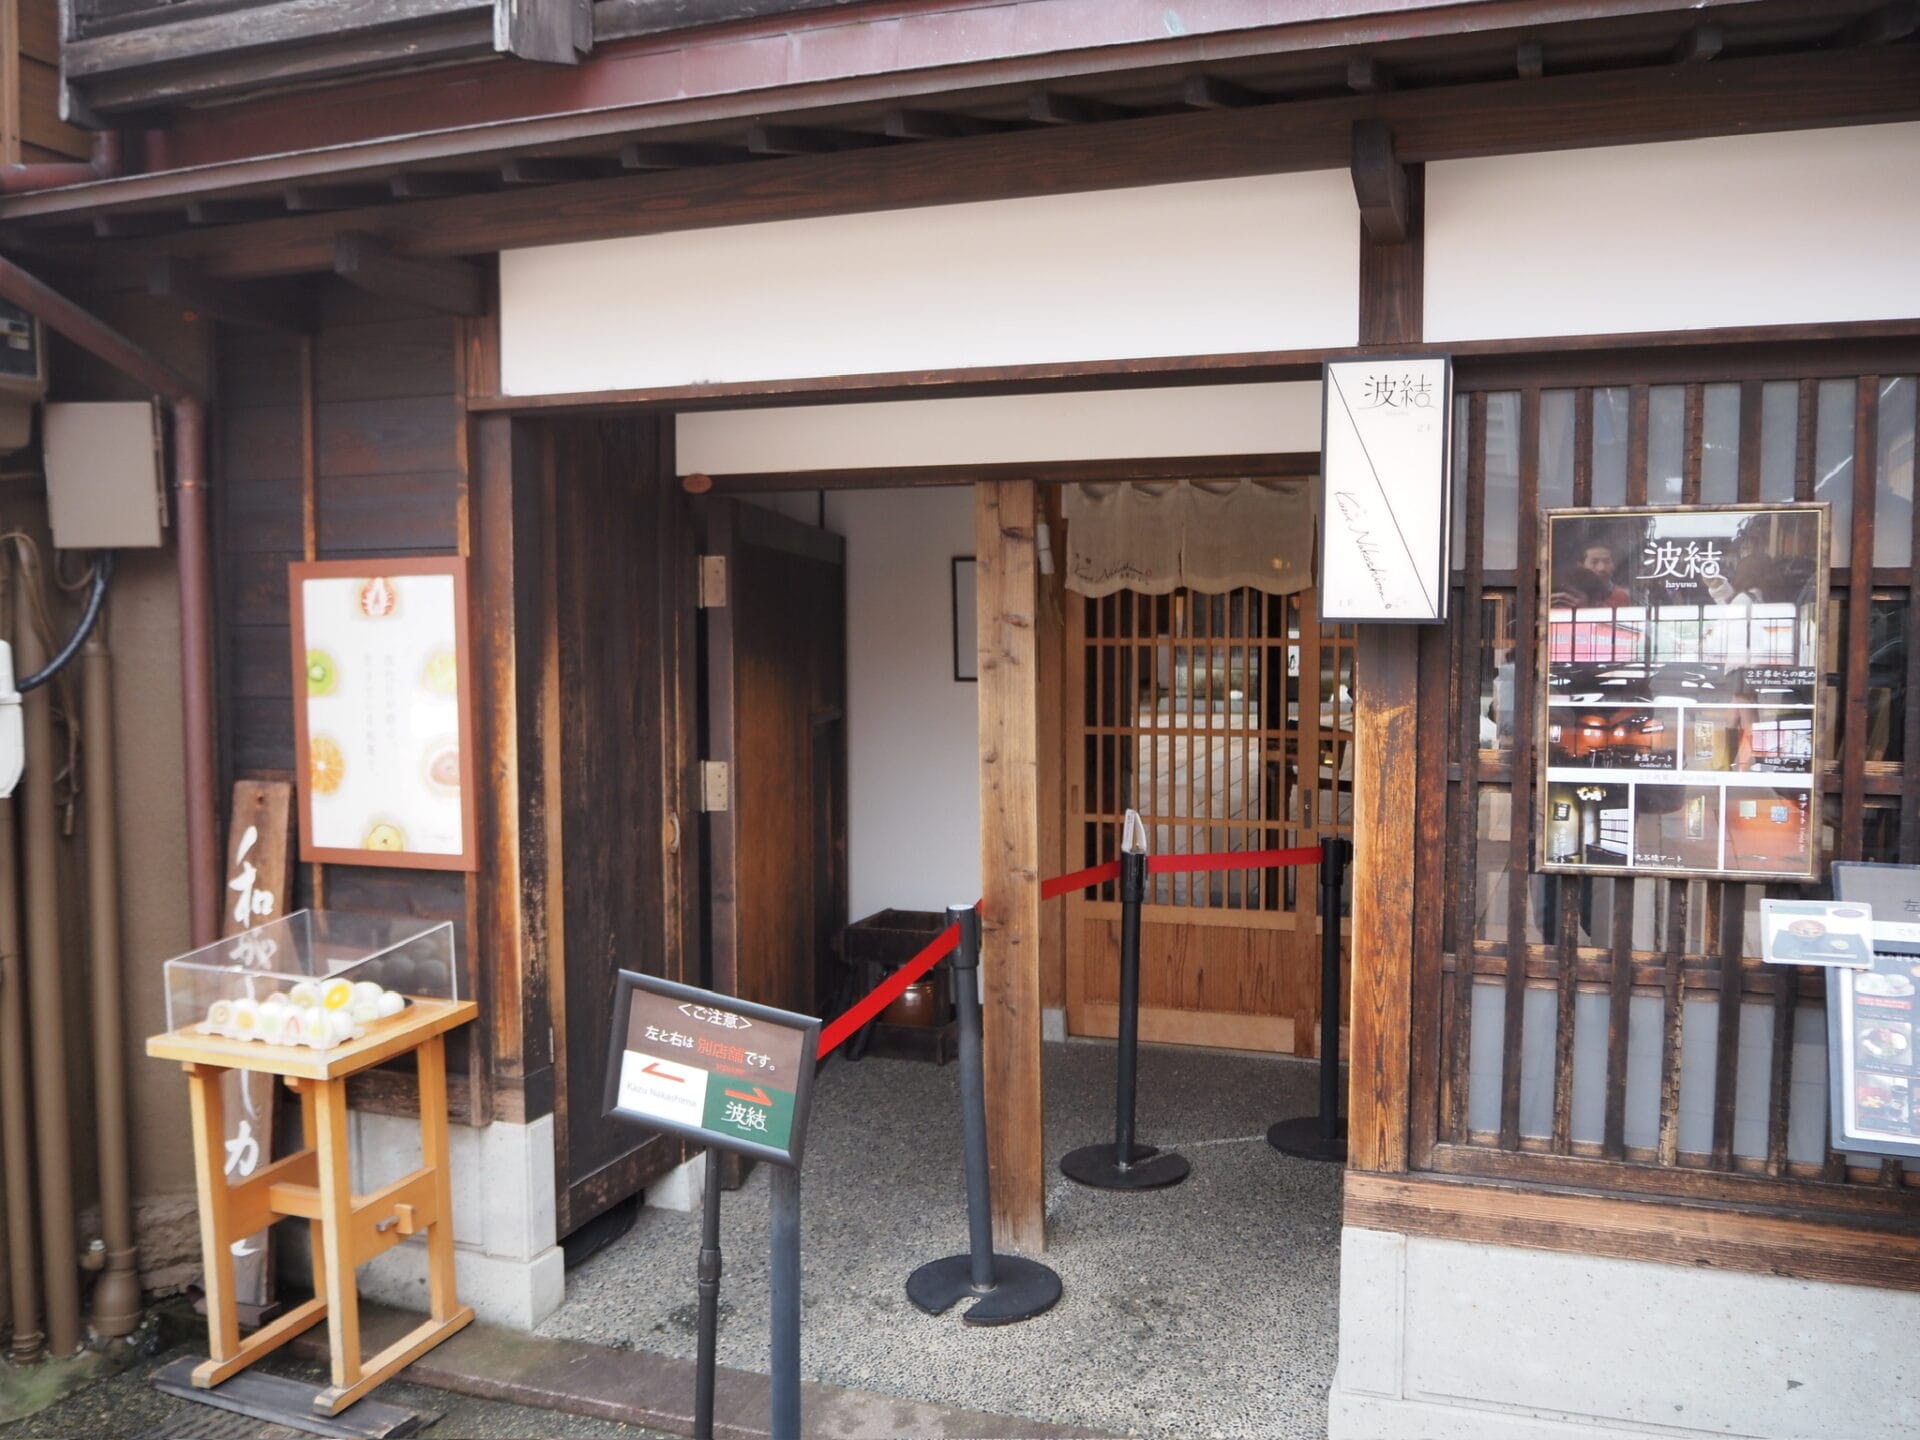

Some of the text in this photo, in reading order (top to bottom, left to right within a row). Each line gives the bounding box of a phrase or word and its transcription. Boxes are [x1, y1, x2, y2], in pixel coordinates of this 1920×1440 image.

[1362, 373, 1434, 408] 波結
[1641, 541, 1724, 579] 波結
[1665, 580, 1698, 590] hayuwa
[722, 1101, 768, 1132] 波結
